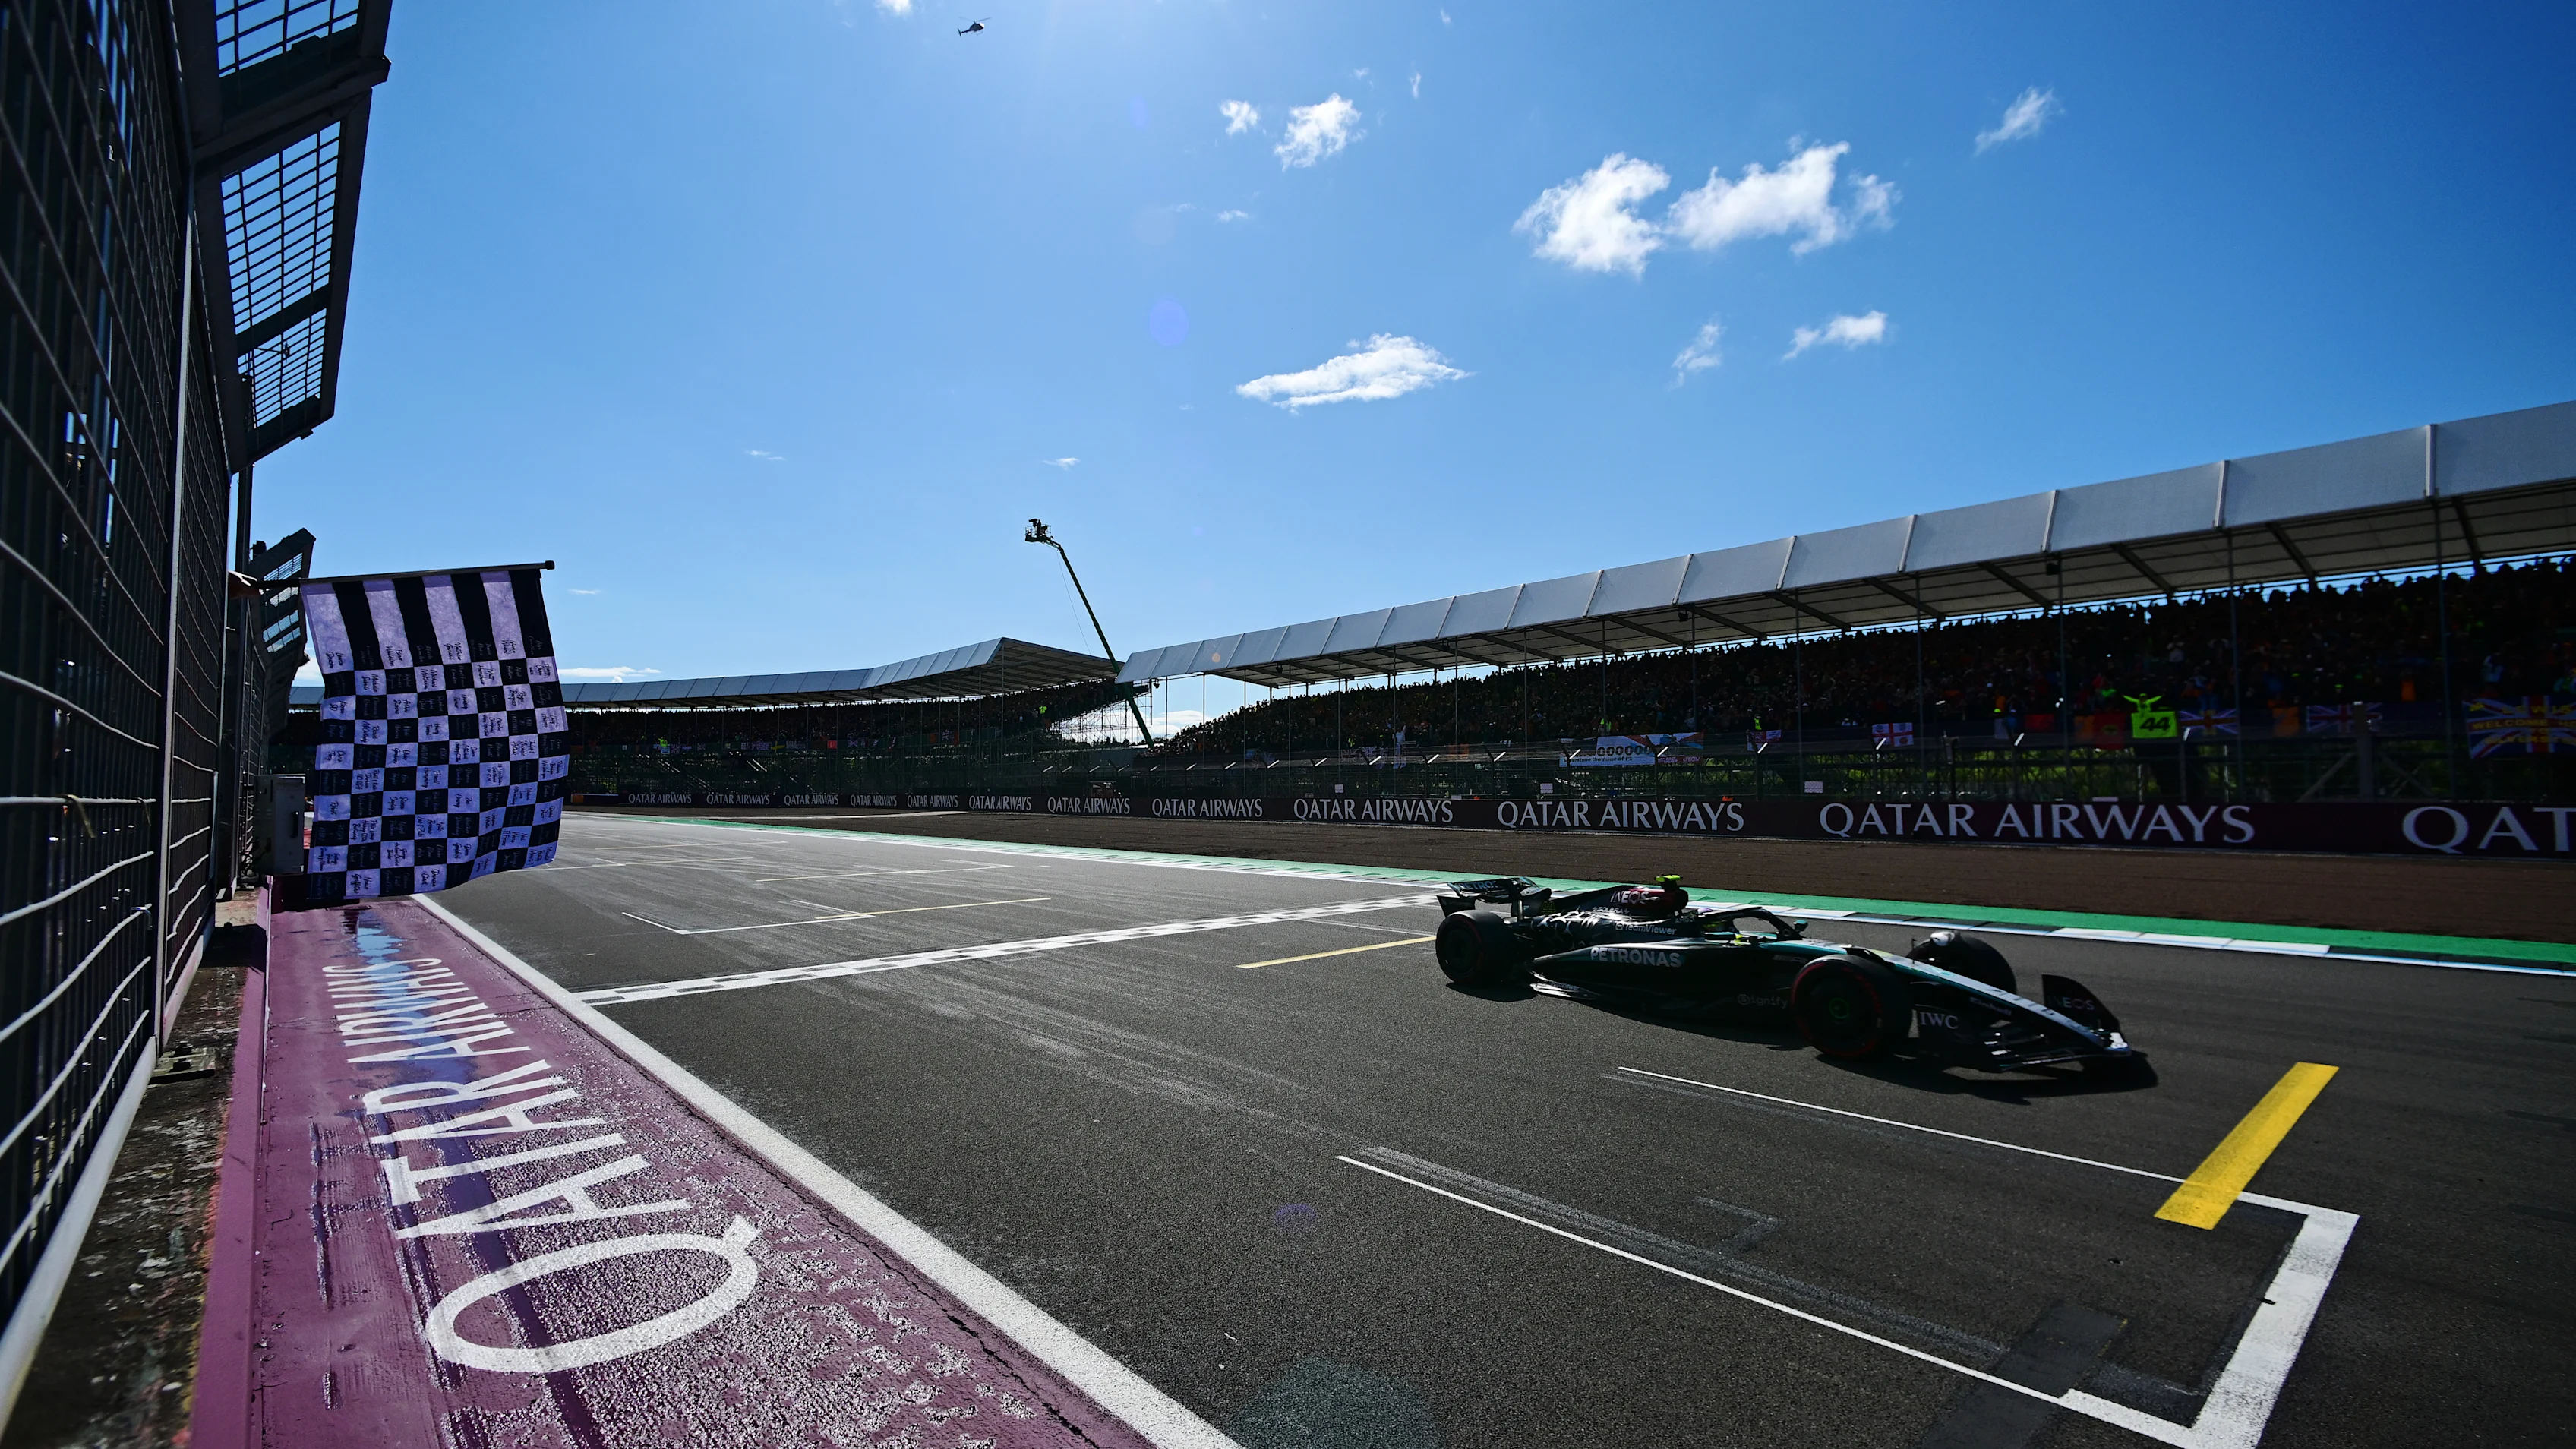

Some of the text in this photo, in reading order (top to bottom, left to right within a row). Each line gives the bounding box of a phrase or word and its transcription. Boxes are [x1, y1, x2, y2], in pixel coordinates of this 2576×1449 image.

[2140, 718, 2170, 731] 44
[2472, 718, 2548, 729] WELCOME
[628, 794, 692, 804] QATAR AIRWAYS
[706, 794, 770, 805] QATAR AIRWAYS
[784, 794, 838, 806] QATAR AIRWAYS
[850, 795, 897, 807] QATAR AIRWAYS
[907, 795, 958, 808] QATAR AIRWAYS
[968, 795, 1031, 811] QATAR AIRWAYS
[1047, 797, 1131, 814] QATAR AIRWAYS
[1151, 798, 1263, 817] QATAR AIRWAYS
[1293, 798, 1454, 822] QATAR AIRWAYS
[1497, 800, 1744, 831] QATAR AIRWAYS
[1818, 803, 2256, 844] QATAR AIRWAYS
[1609, 890, 1652, 904] INEOS
[1541, 901, 1556, 912] 44
[1624, 923, 1678, 936] TeamViewer
[1589, 946, 1682, 968] PETRONAS
[2047, 994, 2095, 1011] INEOS
[1920, 1012, 1959, 1030] IWC
[322, 958, 762, 1374] QATAR AIRWAYS
